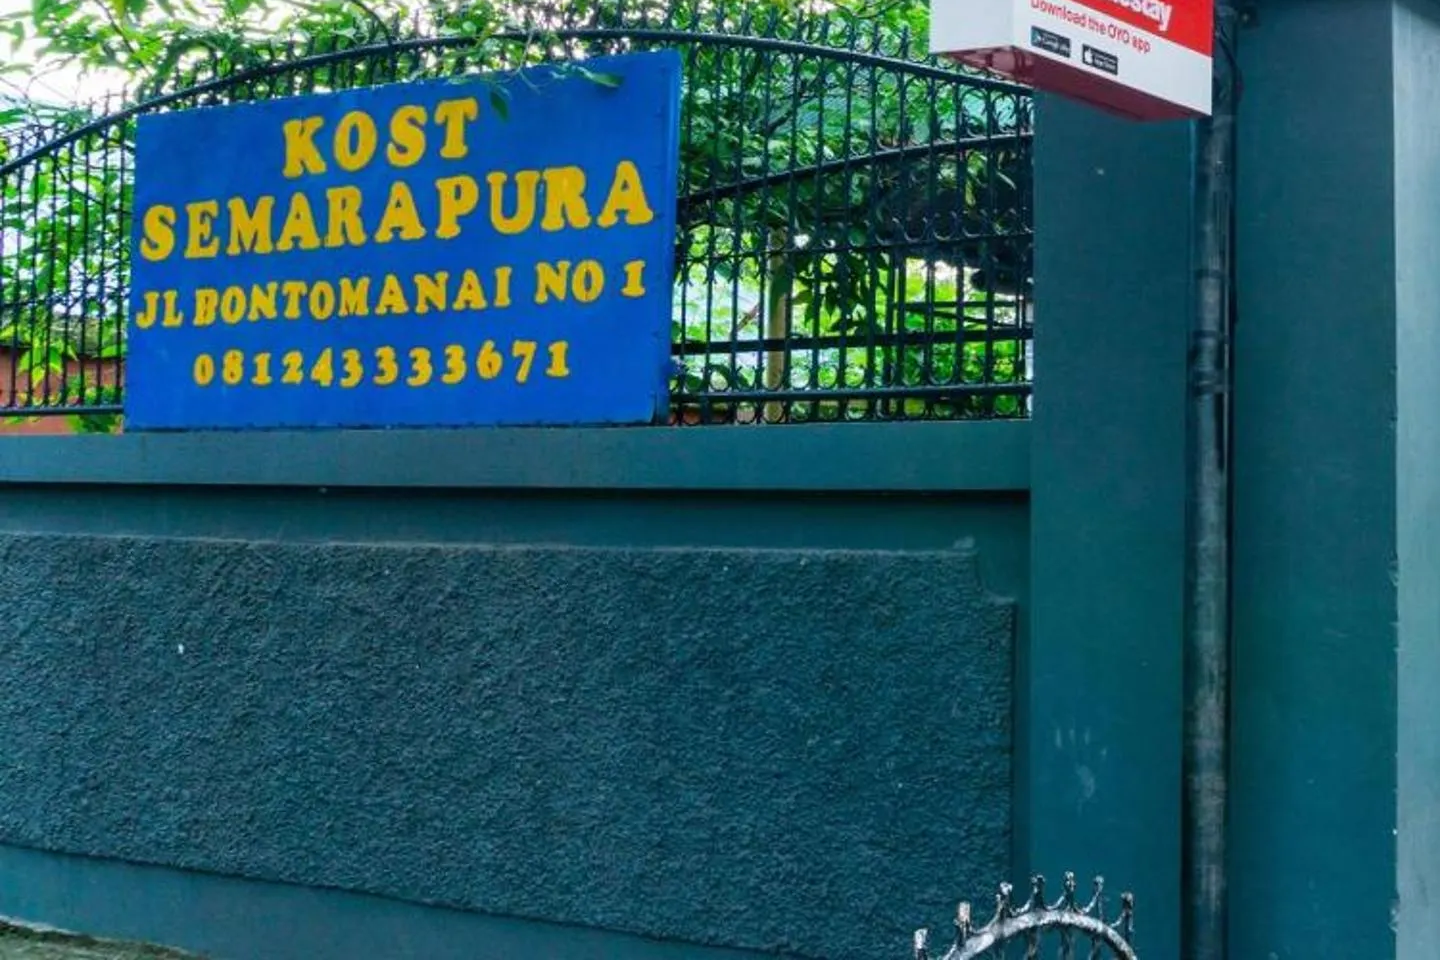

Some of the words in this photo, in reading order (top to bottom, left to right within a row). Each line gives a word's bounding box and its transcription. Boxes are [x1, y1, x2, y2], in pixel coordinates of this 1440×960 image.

[1132, 35, 1151, 54] app
[282, 97, 479, 179] KOST
[139, 160, 654, 262] SEMARAPURA
[136, 290, 183, 328] JL
[192, 265, 513, 327] BONTOMANAI
[535, 259, 605, 304] NO
[621, 260, 647, 298] 1
[193, 340, 571, 389] 081243333671
